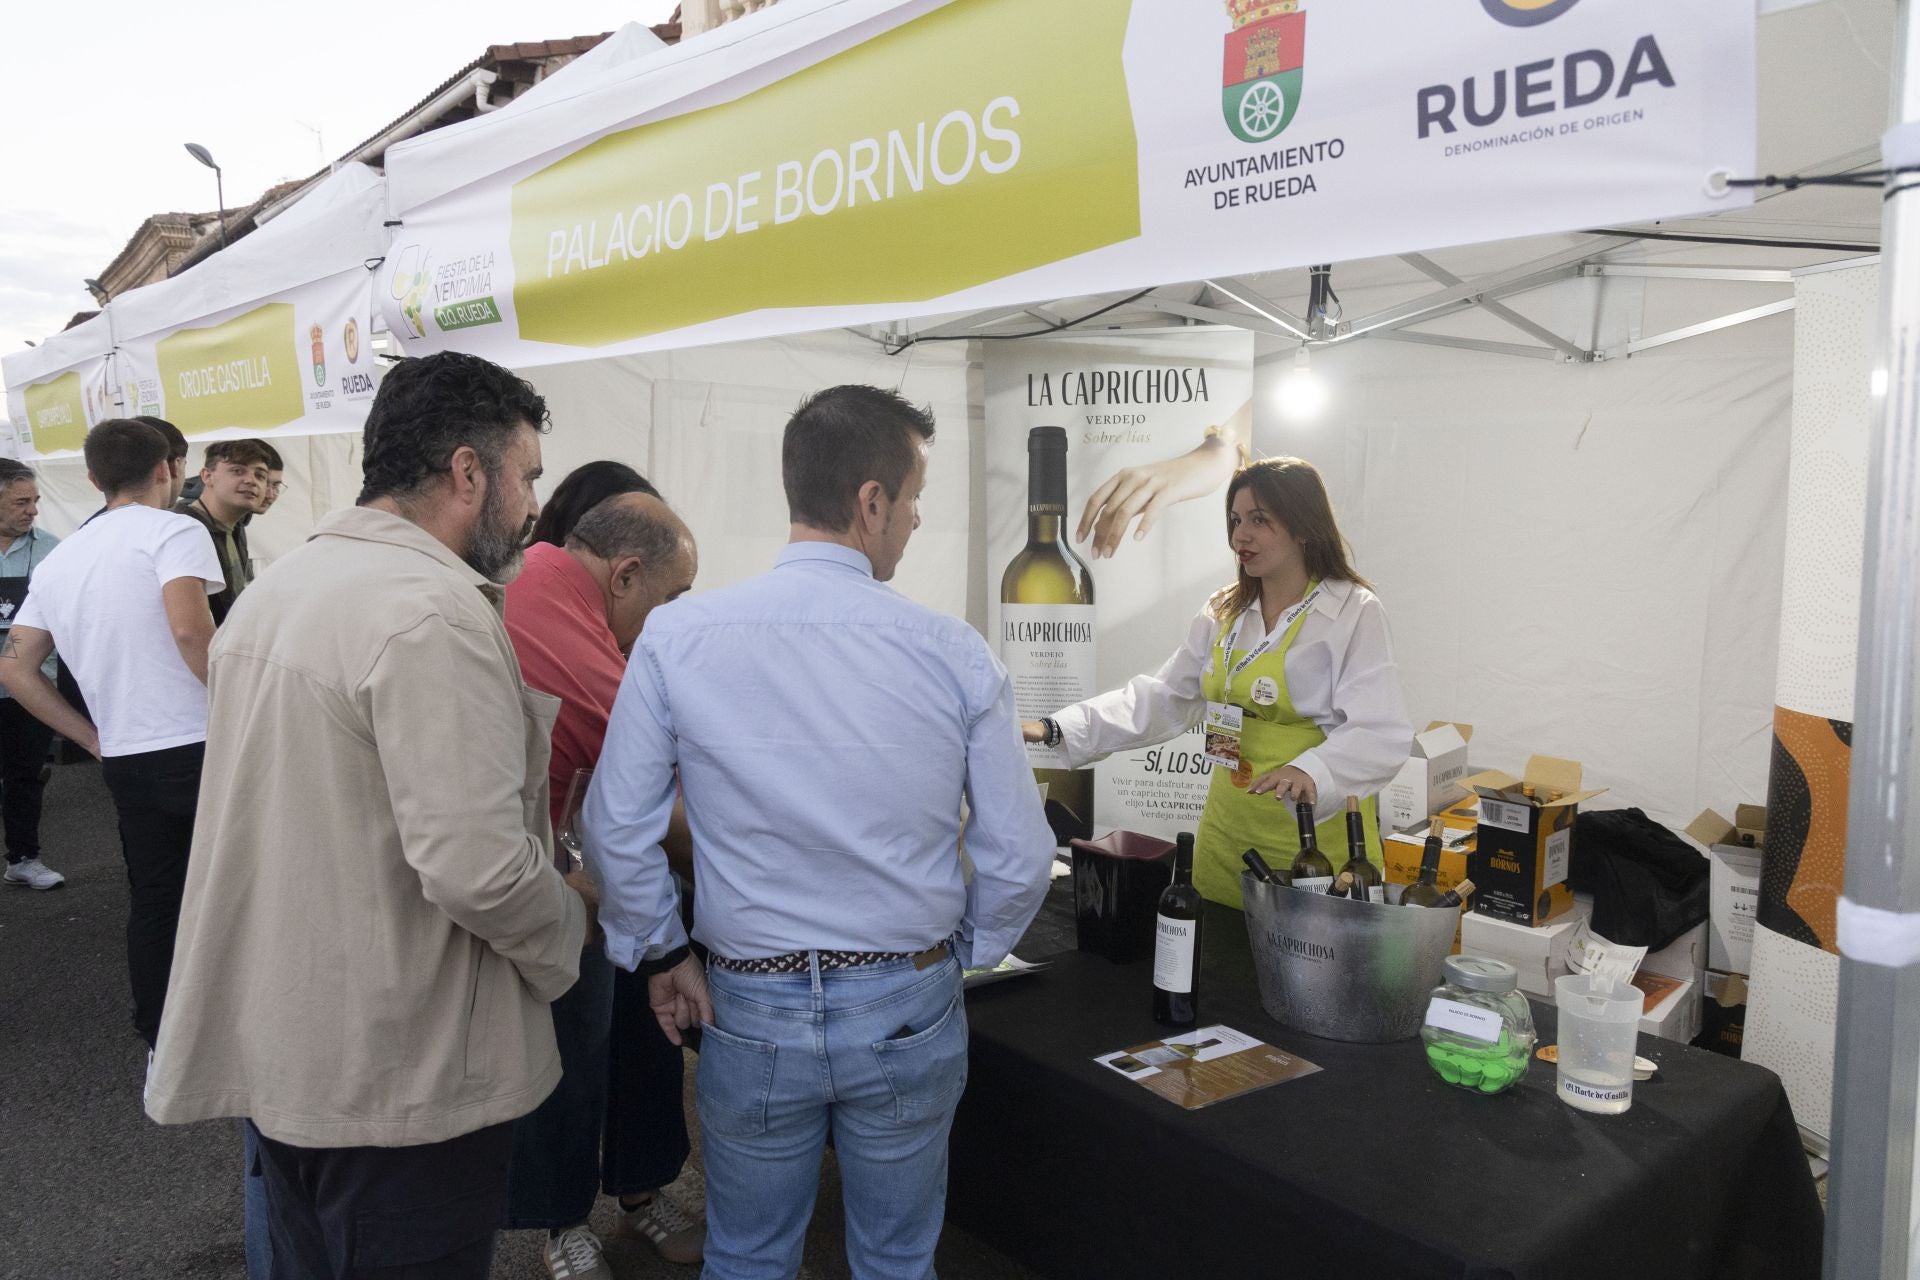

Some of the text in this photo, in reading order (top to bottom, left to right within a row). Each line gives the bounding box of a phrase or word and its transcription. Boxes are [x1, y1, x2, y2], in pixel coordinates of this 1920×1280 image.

[1417, 34, 1676, 139] RUEDA
[1444, 108, 1644, 157] DENOMINACIÓN DE ORIGEN
[1184, 138, 1344, 188] AYUNTAMIENTO
[548, 95, 1021, 279] PALACIO DE BORNOS
[1214, 174, 1316, 210] DE RUEDA
[437, 251, 495, 279] FIESTA DE LA
[435, 272, 492, 302] VENDIMIA
[456, 301, 495, 324] RUEDA
[179, 355, 272, 399] ORO DE CASTILLA
[342, 373, 374, 395] RUEDA
[1028, 368, 1209, 406] LA CAPRICHOSA
[1086, 414, 1146, 426] VERDEJO
[1083, 431, 1122, 445] Sobre
[1005, 621, 1092, 643] LA CAPRICHOSA
[1167, 752, 1188, 774] LO
[1112, 777, 1131, 786] Vivir
[1135, 779, 1154, 788] para
[1156, 779, 1194, 790] disfrutar
[1125, 799, 1144, 808] elijo
[1146, 800, 1158, 808] LA
[1174, 791, 1188, 799] Por
[1140, 810, 1174, 820] Verdejo
[1490, 857, 1521, 874] BORNOS
[1275, 934, 1335, 961] CAPRICHOSA
[1448, 1008, 1464, 1016] PALACIO
[1565, 1082, 1629, 1100] El Norte de Castilla
